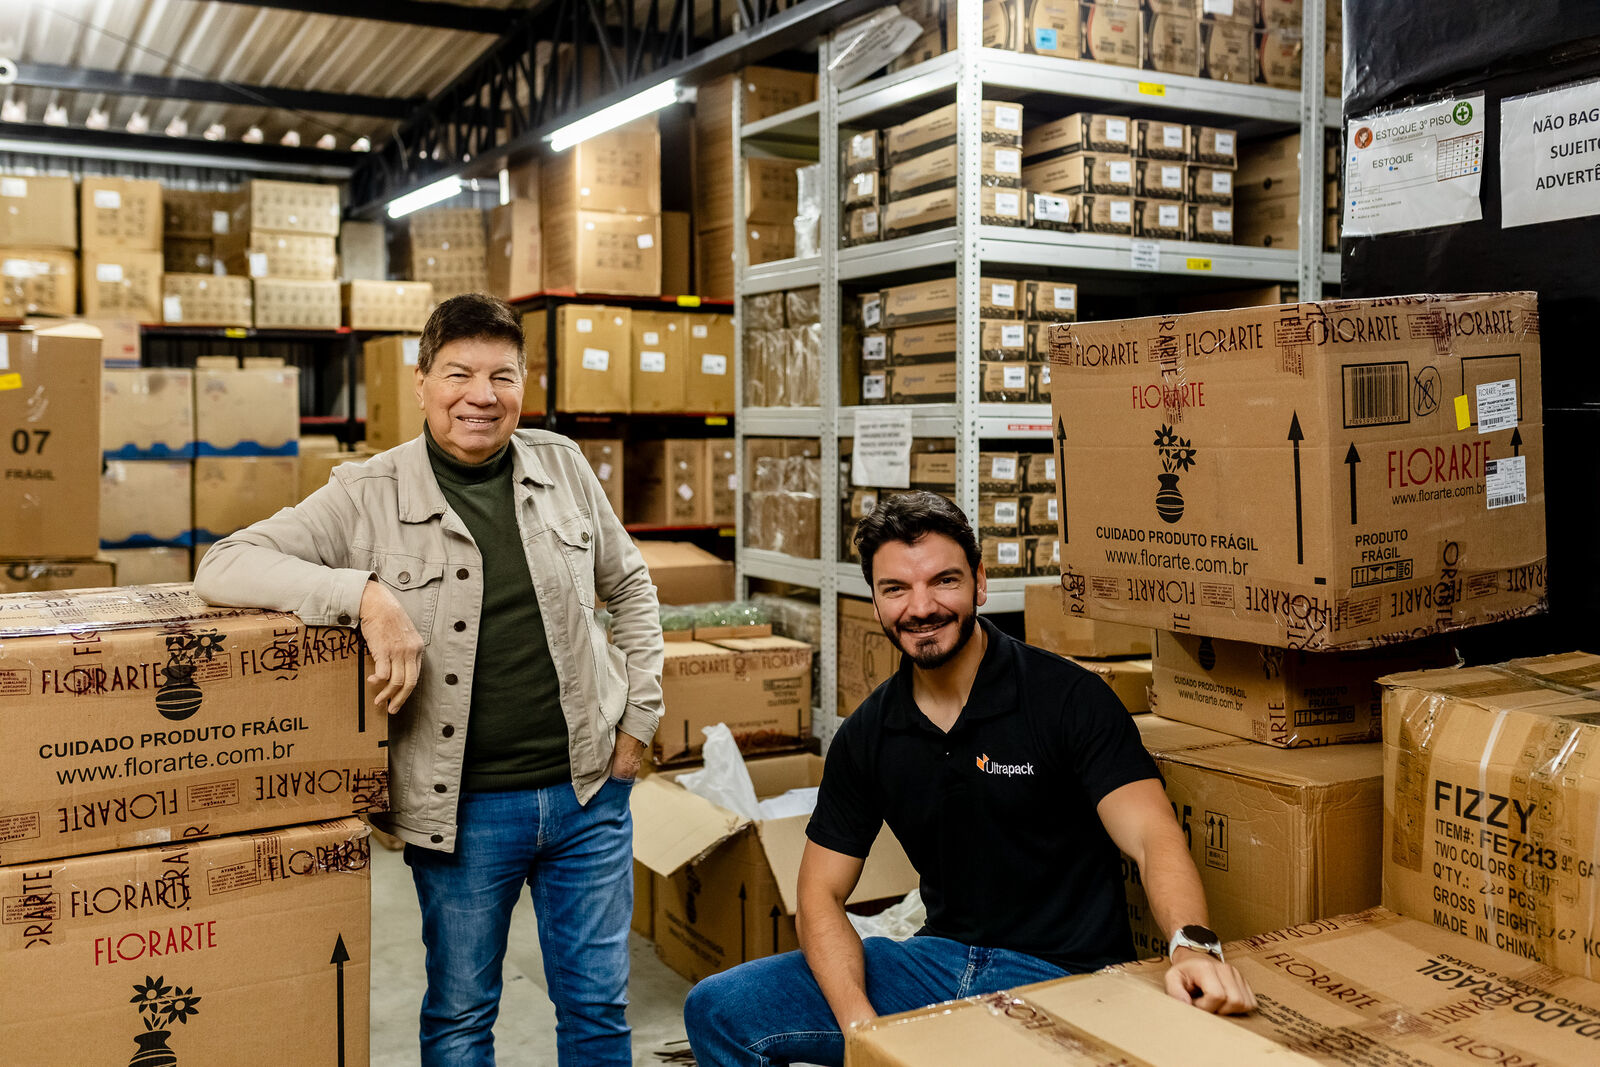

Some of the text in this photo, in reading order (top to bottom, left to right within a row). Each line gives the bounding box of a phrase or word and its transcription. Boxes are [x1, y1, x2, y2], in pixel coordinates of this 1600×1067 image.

[1376, 124, 1417, 140] ESTOQUE
[1430, 114, 1452, 127] PISO
[1533, 115, 1564, 134] NÃO
[1372, 153, 1414, 168] ESTOQUE
[1075, 341, 1139, 367] FLORARTE
[1186, 324, 1263, 357] FLORARTE
[1133, 382, 1205, 409] FLORARTE
[12, 429, 51, 455] 07
[1391, 484, 1485, 505] www.florarte.com.br
[1096, 526, 1258, 551] CUIDADO PRODUTO FRÁGIL
[1355, 529, 1408, 547] PRODUTO
[1105, 549, 1248, 576] www.florarte.com.br
[1361, 547, 1400, 563] FRÁGIL
[1127, 578, 1195, 605] FLORARTE
[41, 662, 162, 694] FLORARTE
[679, 658, 730, 676] FLORARTE
[1174, 675, 1247, 699] CUIDADO PRODUTO FRÁGIL
[1178, 689, 1243, 711] www.florarte.com.br
[39, 716, 309, 759] CUIDADO PRODUTO FRÁGIL
[56, 740, 295, 785] www.florarte.com.br
[985, 761, 1035, 778] Ultrapack
[58, 788, 179, 834] FLORARTE
[1435, 780, 1537, 834] FIZZY
[1435, 819, 1557, 870] ITEM#: FE7213
[1435, 840, 1457, 861] TWO
[1461, 848, 1516, 881] COLORS
[71, 878, 191, 918] FLORARTE
[1433, 886, 1476, 914] GROSS
[1509, 887, 1536, 911] PCS
[1433, 909, 1468, 936] MADE
[1475, 924, 1488, 944] IN
[94, 921, 217, 966] FLORARTE
[1436, 953, 1486, 975] CAIXAS
[1265, 951, 1381, 1010] FLORARTE
